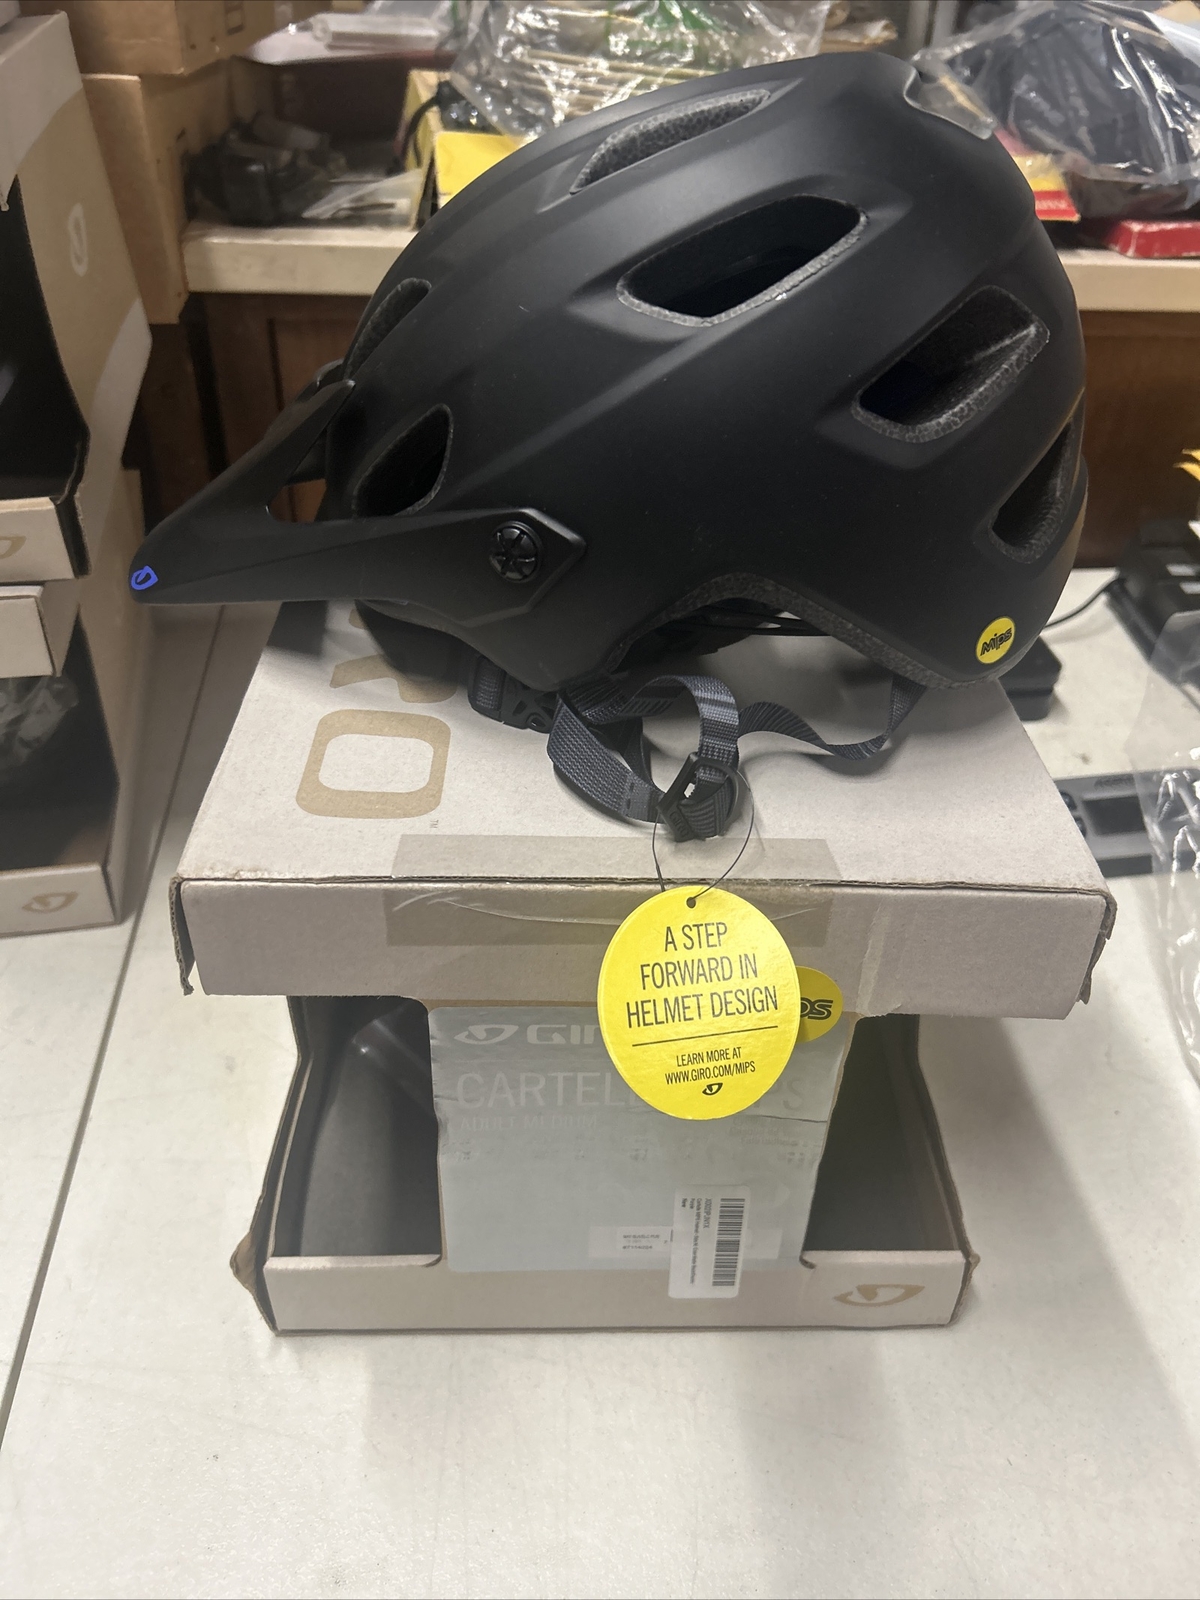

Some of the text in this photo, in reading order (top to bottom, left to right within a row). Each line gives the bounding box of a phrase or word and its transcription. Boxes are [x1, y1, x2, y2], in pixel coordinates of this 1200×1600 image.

[980, 628, 1012, 656] Mips
[664, 922, 727, 952] A STEP
[640, 953, 758, 990] FORWARD IN
[626, 986, 778, 1028] HELMET DESIGN
[676, 1046, 742, 1067] LEARN MORE AT
[664, 1060, 756, 1085] WWW.GIRO.COM/MIPS
